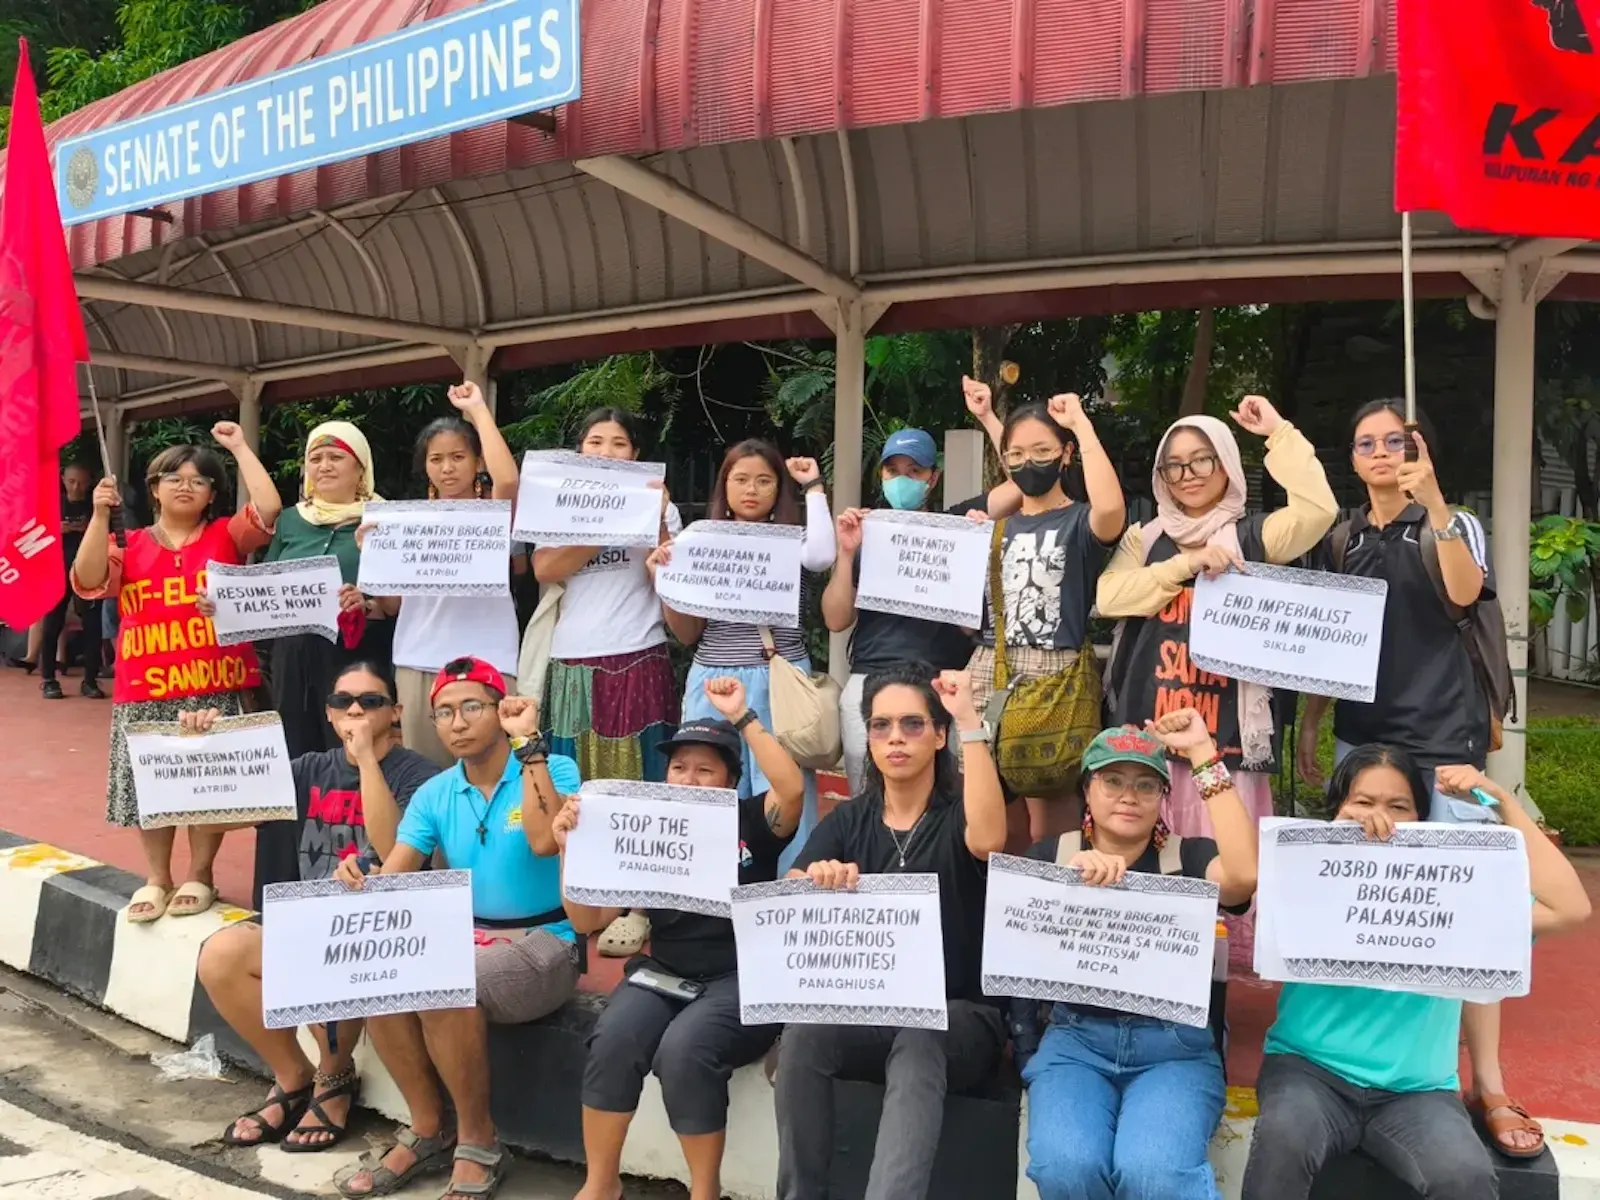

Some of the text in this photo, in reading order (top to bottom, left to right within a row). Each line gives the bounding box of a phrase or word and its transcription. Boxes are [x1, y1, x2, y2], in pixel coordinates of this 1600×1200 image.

[105, 8, 560, 197] SENATE OF THE PHILIPPINES
[555, 493, 626, 510] MINDORO!
[402, 525, 454, 537] INFANTRY
[370, 539, 506, 550] ITIGIL ANG WHITE TERROR
[890, 533, 956, 553] 4TH INFANTRY
[401, 553, 472, 564] SA MINDORO!
[688, 546, 771, 562] KAPAYAPAAN NA
[416, 568, 459, 577] KATRIBU
[692, 561, 767, 577] NAKABATAY SA
[897, 564, 951, 582] PALAYASIN!
[216, 582, 327, 599] RESUME PEACE
[735, 577, 794, 592] IPAGLABAN!
[233, 599, 322, 613] TALKS NOW!
[1223, 593, 1352, 624] END IMPERIALIST
[1203, 608, 1368, 647] PLUNDER IN MINDORO!
[1263, 640, 1306, 654] SIKLAB
[139, 746, 279, 766] UPHOLD INTERNATIONAL
[154, 763, 271, 780] HUMANITARIAN LAW!
[193, 784, 237, 795] KATRIBU
[610, 812, 689, 837] STOP THE
[614, 836, 694, 861] KILLINGS!
[619, 861, 690, 877] PANAGHIUSA
[1319, 859, 1474, 883] 203RD INFANTRY
[1357, 884, 1441, 907] BRIGADE,
[755, 907, 921, 926] STOP MILITARIZATION
[1063, 904, 1121, 919] INFANTRY
[1345, 905, 1454, 929] PALAYASIN!
[329, 909, 413, 937] DEFEND
[1060, 915, 1082, 928] LGU
[1087, 918, 1103, 930] NG
[1167, 929, 1201, 943] ITIGIL
[783, 930, 895, 948] IN INDIGENOUS
[1005, 920, 1199, 957] ANG SABWATAN PARA SA HUWAD
[1356, 932, 1437, 949] SANDUGO
[323, 936, 426, 966] MINDORO!
[1060, 940, 1141, 962] NA HUSTISYA!
[786, 952, 896, 971] COMMUNITIES!
[1076, 959, 1119, 975] MCPA
[349, 969, 398, 984] SIKLAB
[799, 978, 885, 990] PANAGHIUSA
